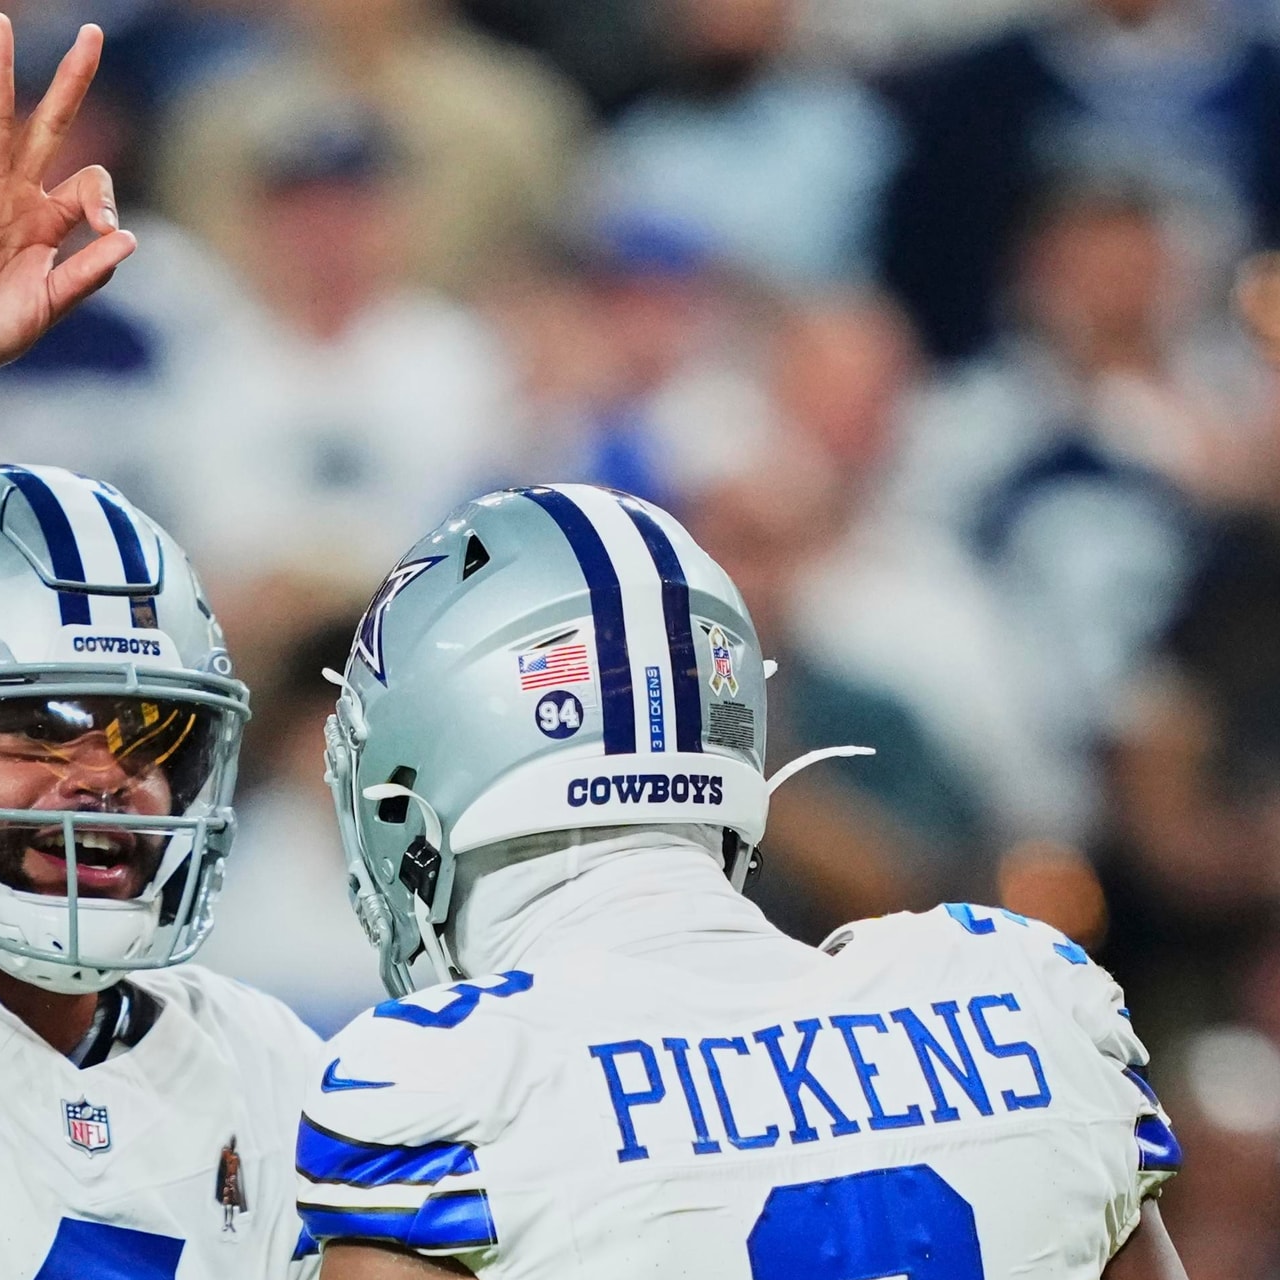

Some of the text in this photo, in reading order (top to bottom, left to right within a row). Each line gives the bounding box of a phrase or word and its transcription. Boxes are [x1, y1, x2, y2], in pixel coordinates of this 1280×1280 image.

[73, 636, 161, 656] COWBOYS
[538, 697, 580, 732] 94
[647, 668, 662, 734] PICKENS
[567, 773, 723, 808] COWBOYS
[588, 992, 1053, 1163] PICKENS
[71, 1120, 106, 1145] NFL
